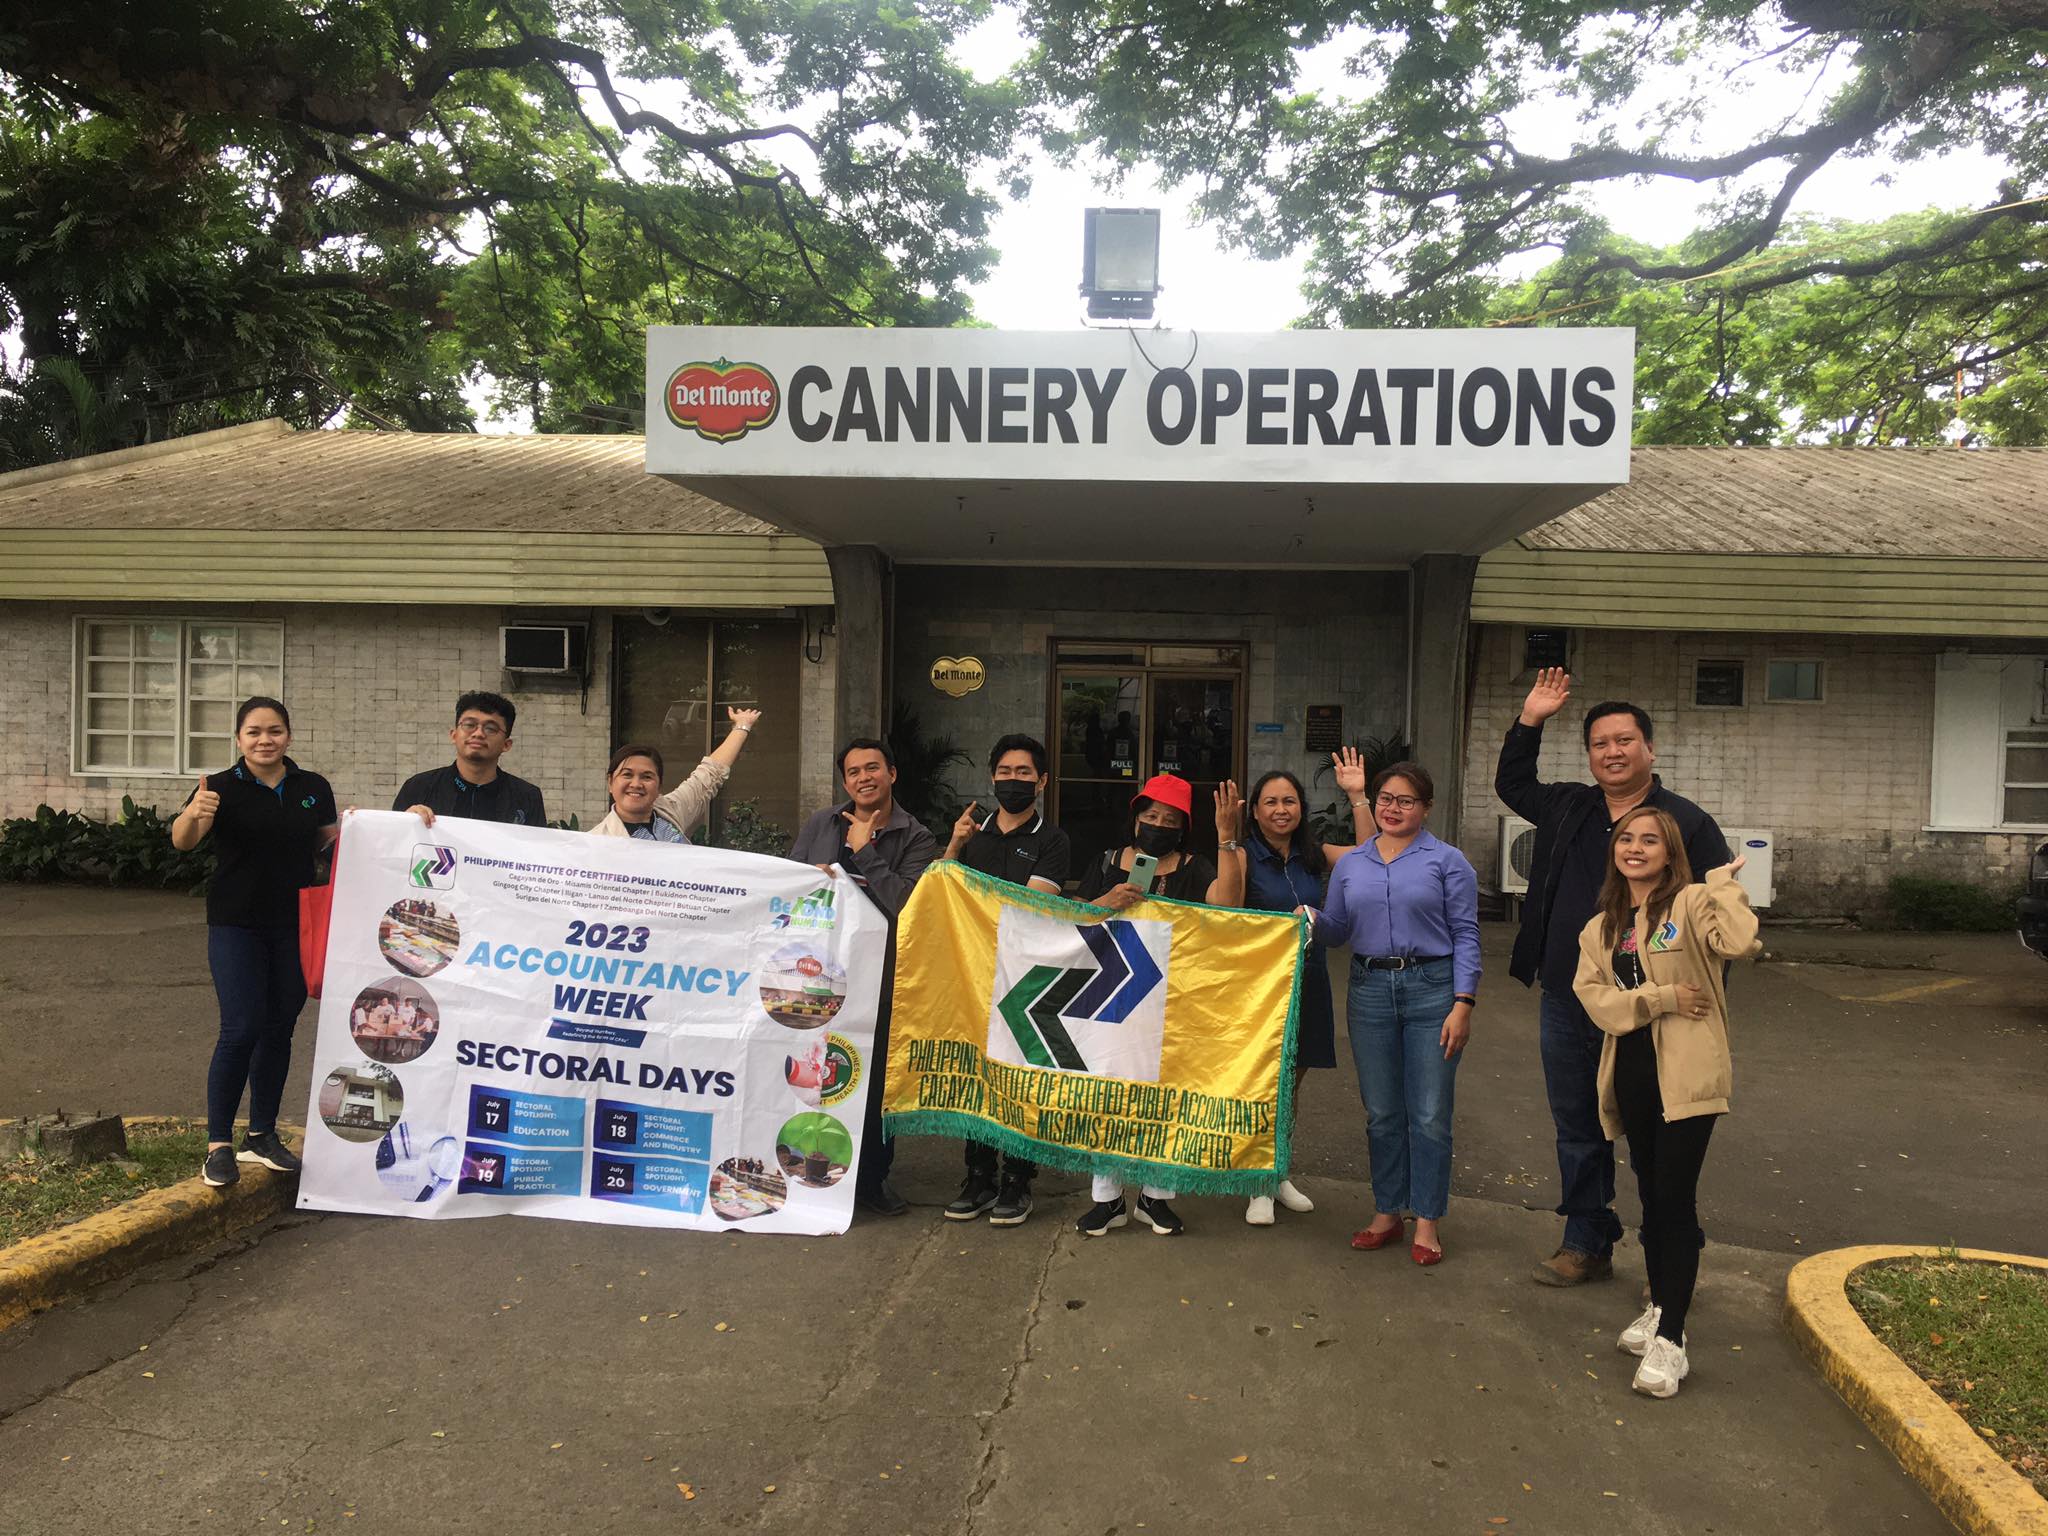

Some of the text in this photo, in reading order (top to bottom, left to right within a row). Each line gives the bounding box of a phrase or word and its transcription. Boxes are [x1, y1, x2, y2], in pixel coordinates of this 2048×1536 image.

[675, 384, 772, 408] Del Monte
[788, 365, 1617, 447] CANNERY OPERATIONS
[934, 669, 981, 680] Del Monte
[1111, 760, 1133, 768] PULL
[1159, 762, 1181, 770] PULL
[464, 856, 747, 897] PHILIPPINE INSTITUTE OF CERTIFIED PUBLIC ACCOUNTANTS
[509, 873, 536, 882] Cagayan
[547, 877, 559, 885] Oro
[565, 880, 592, 889] Misamis
[593, 883, 621, 893] Oriental
[622, 886, 650, 896] Chapter
[655, 890, 688, 899] Bukidnon
[689, 894, 717, 903] Chapter
[493, 881, 519, 891] Gingoog
[519, 883, 533, 892] City
[533, 886, 560, 895] Chapter
[565, 890, 583, 898] Iligan
[623, 896, 642, 905] Norte
[644, 899, 672, 909] Chapter
[677, 902, 701, 911] Butuan
[703, 904, 731, 914] Chapter
[515, 893, 540, 903] Surigao
[552, 897, 571, 905] Norte
[572, 900, 599, 910] Chapter
[604, 903, 644, 915] Zamboanga
[645, 907, 657, 915] Del
[658, 909, 678, 918] Norte
[679, 912, 707, 921] Chapter
[565, 920, 651, 953] 2023
[465, 941, 750, 997] ACCOUNTANCY
[553, 984, 654, 1020] WEEK
[830, 1036, 860, 1073] PHILIPPINES
[455, 1040, 735, 1097] SECTORAL DAYS
[835, 1078, 859, 1103] HEALTH
[908, 1039, 979, 1076] PHILIPPINE
[1036, 1071, 1058, 1107] OF
[1057, 1074, 1125, 1116] CERTIFIED
[1126, 1083, 1177, 1122] PUBLIC
[1177, 1089, 1270, 1137] ACCOUNTANTS
[486, 1101, 500, 1109] July
[515, 1101, 552, 1111] SECTORAL
[486, 1112, 499, 1125] 17
[514, 1110, 557, 1119] SPOTLIGHT:
[613, 1114, 628, 1122] July
[644, 1115, 682, 1124] SECTORAL
[918, 1073, 984, 1113] CAGAYAN
[988, 1087, 1000, 1121] DE
[1001, 1097, 1025, 1132] ORO
[1037, 1109, 1102, 1149] MISAMIS
[1103, 1117, 1169, 1159] ORIENTAL
[1171, 1127, 1233, 1169] CHAPTER
[513, 1126, 570, 1137] EDUCATION
[611, 1125, 627, 1138] 18
[643, 1132, 689, 1143] COMMERCE
[662, 1142, 701, 1154] INDUSTRY
[481, 1157, 496, 1166] July
[511, 1158, 549, 1166] SECTORAL
[478, 1169, 493, 1182] 19
[609, 1166, 624, 1174] July
[645, 1165, 683, 1174] SECTORAL
[513, 1175, 544, 1183] PUBLIC
[607, 1176, 625, 1187] 20
